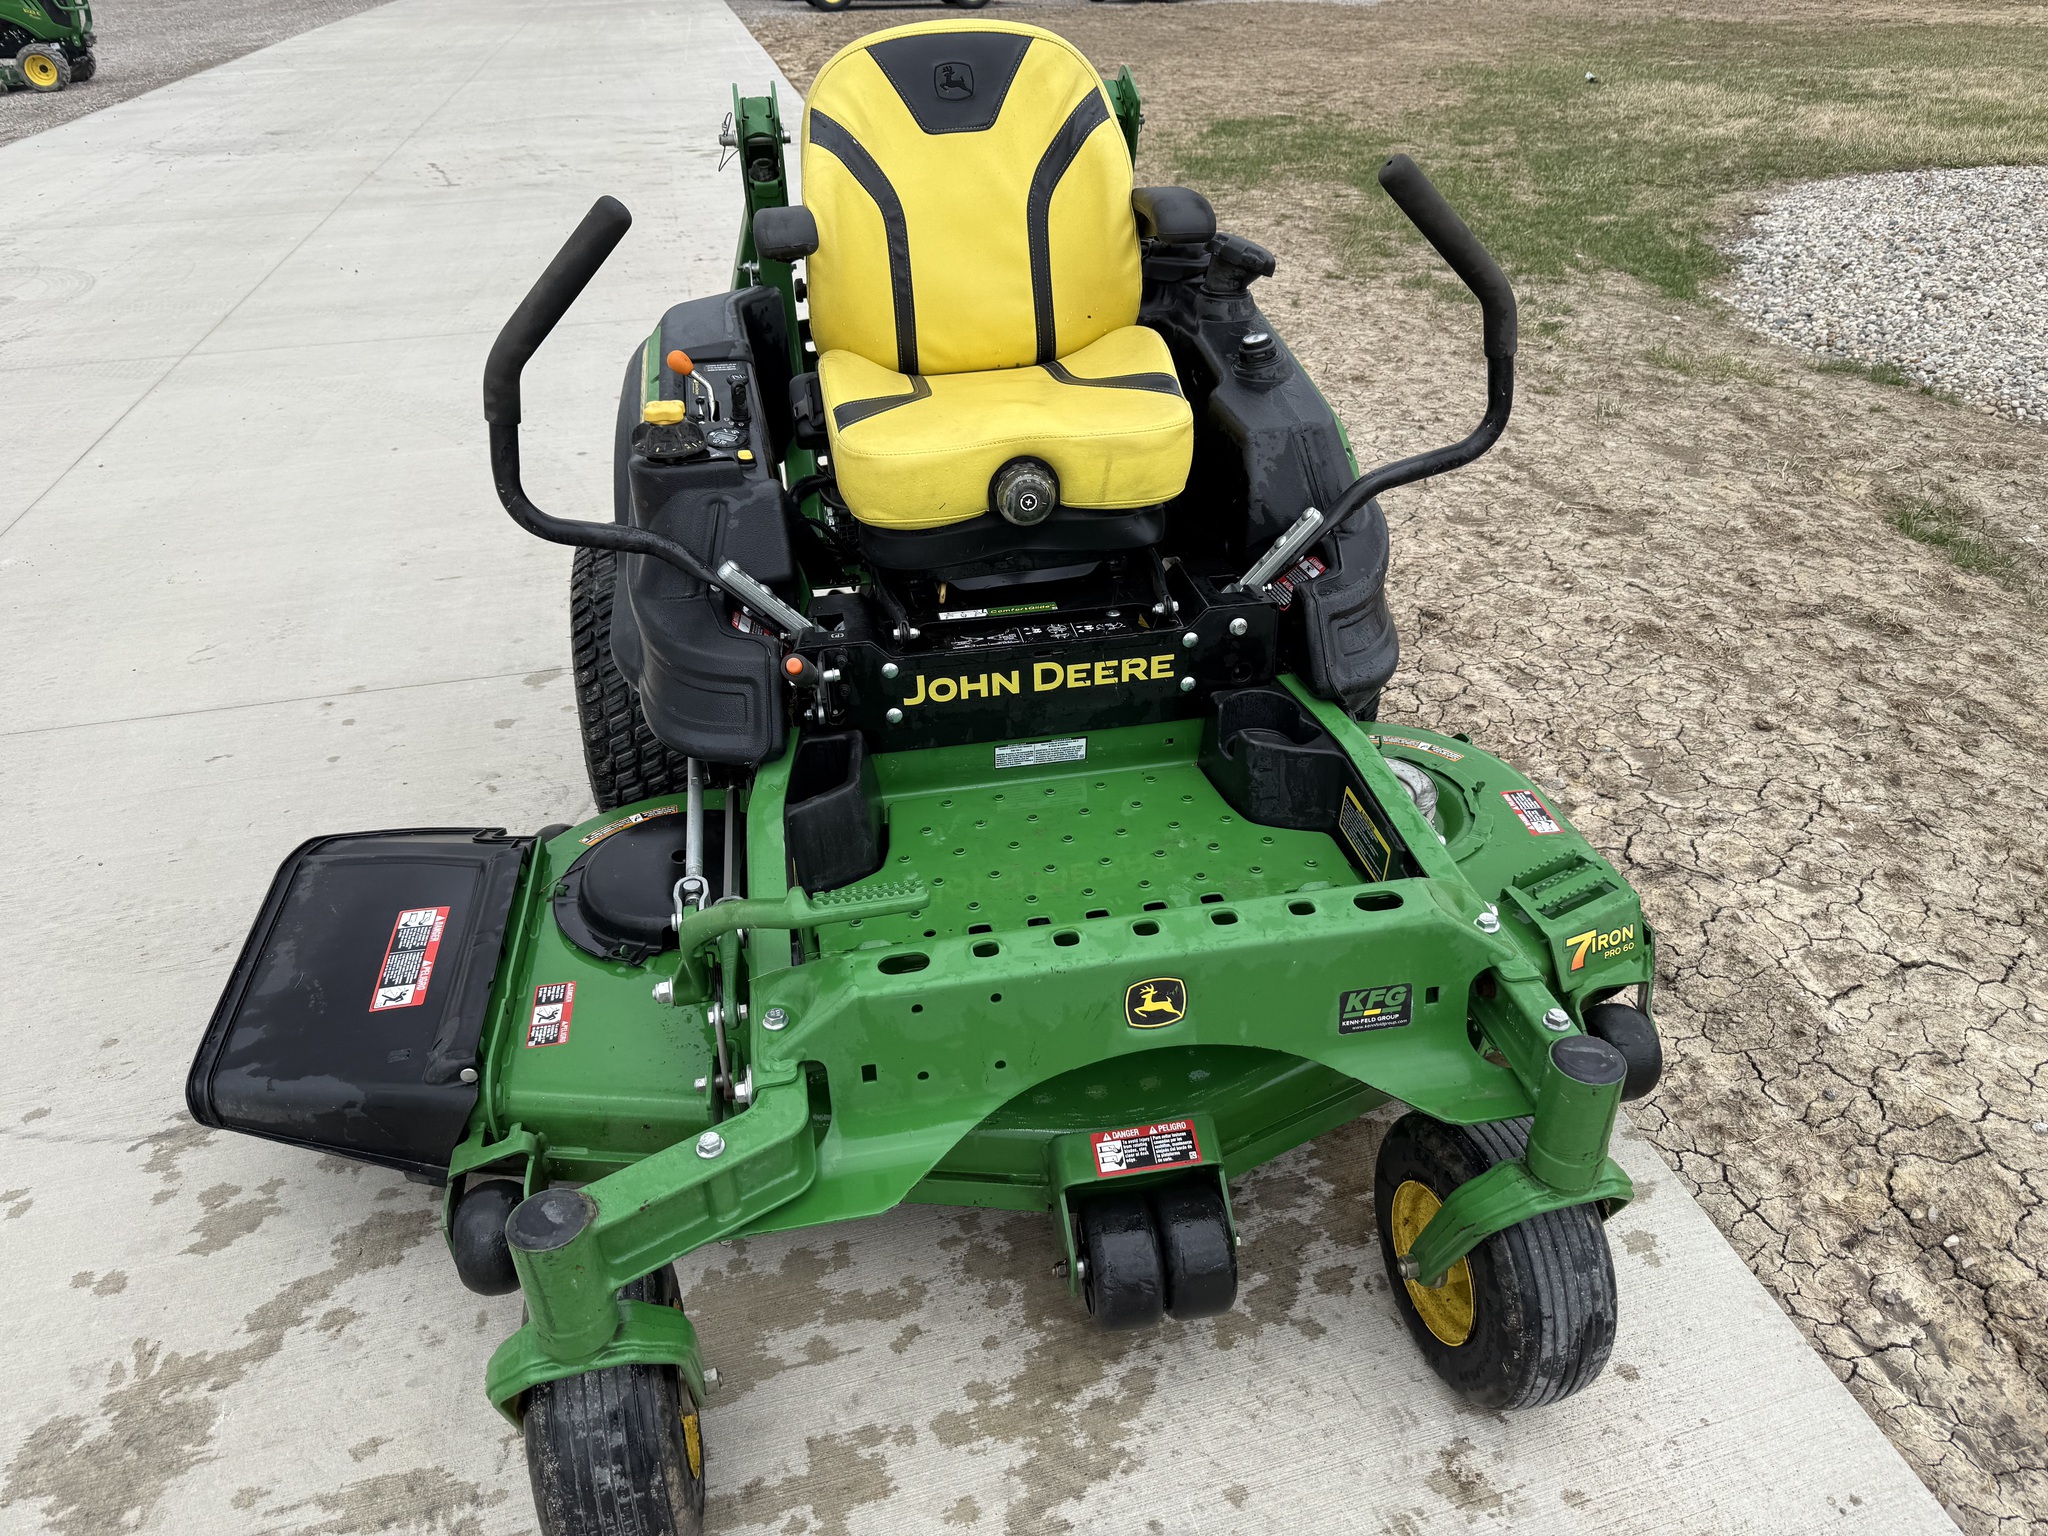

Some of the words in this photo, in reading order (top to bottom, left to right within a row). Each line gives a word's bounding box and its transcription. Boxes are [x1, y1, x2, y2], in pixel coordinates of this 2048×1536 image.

[903, 670, 1020, 706] JOHN
[1033, 654, 1175, 692] DEERE
[1604, 947, 1621, 959] PRO
[1623, 942, 1634, 952] 60
[1345, 986, 1407, 1012] KFG
[1342, 1016, 1376, 1026] KENN-FELD
[1377, 1014, 1399, 1022] GROUP
[1112, 1128, 1139, 1139] DANGER
[1157, 1121, 1186, 1132] PELIGRO
